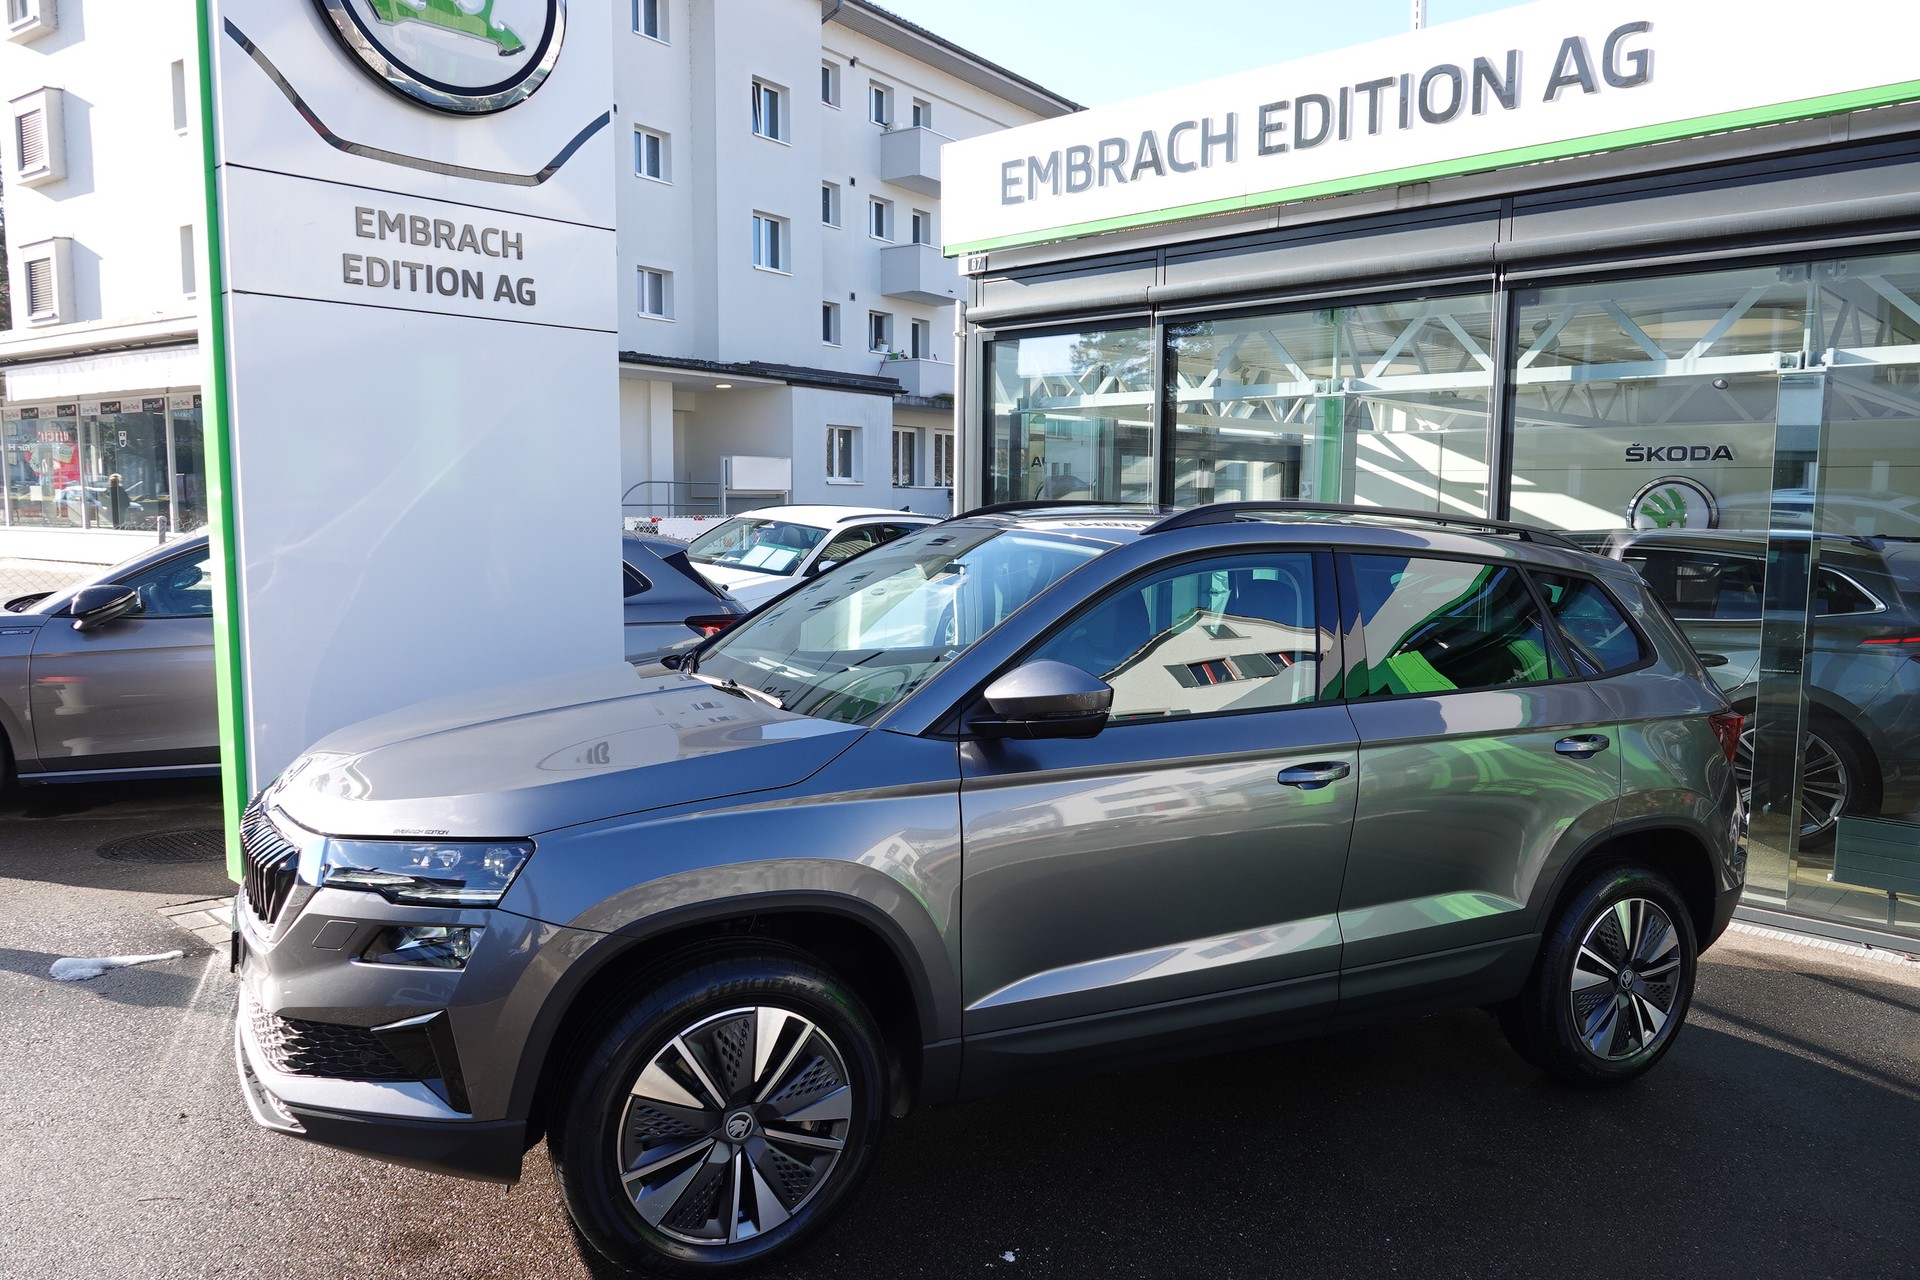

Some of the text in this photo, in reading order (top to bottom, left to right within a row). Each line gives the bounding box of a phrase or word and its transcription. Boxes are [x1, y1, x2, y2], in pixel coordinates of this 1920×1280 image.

[1000, 20, 1655, 205] EMBRACH EDITION AG
[355, 206, 523, 260] EMBRACH
[342, 253, 536, 306] EDITION AG
[971, 257, 982, 270] 87
[1625, 443, 1734, 462] ŠKODA
